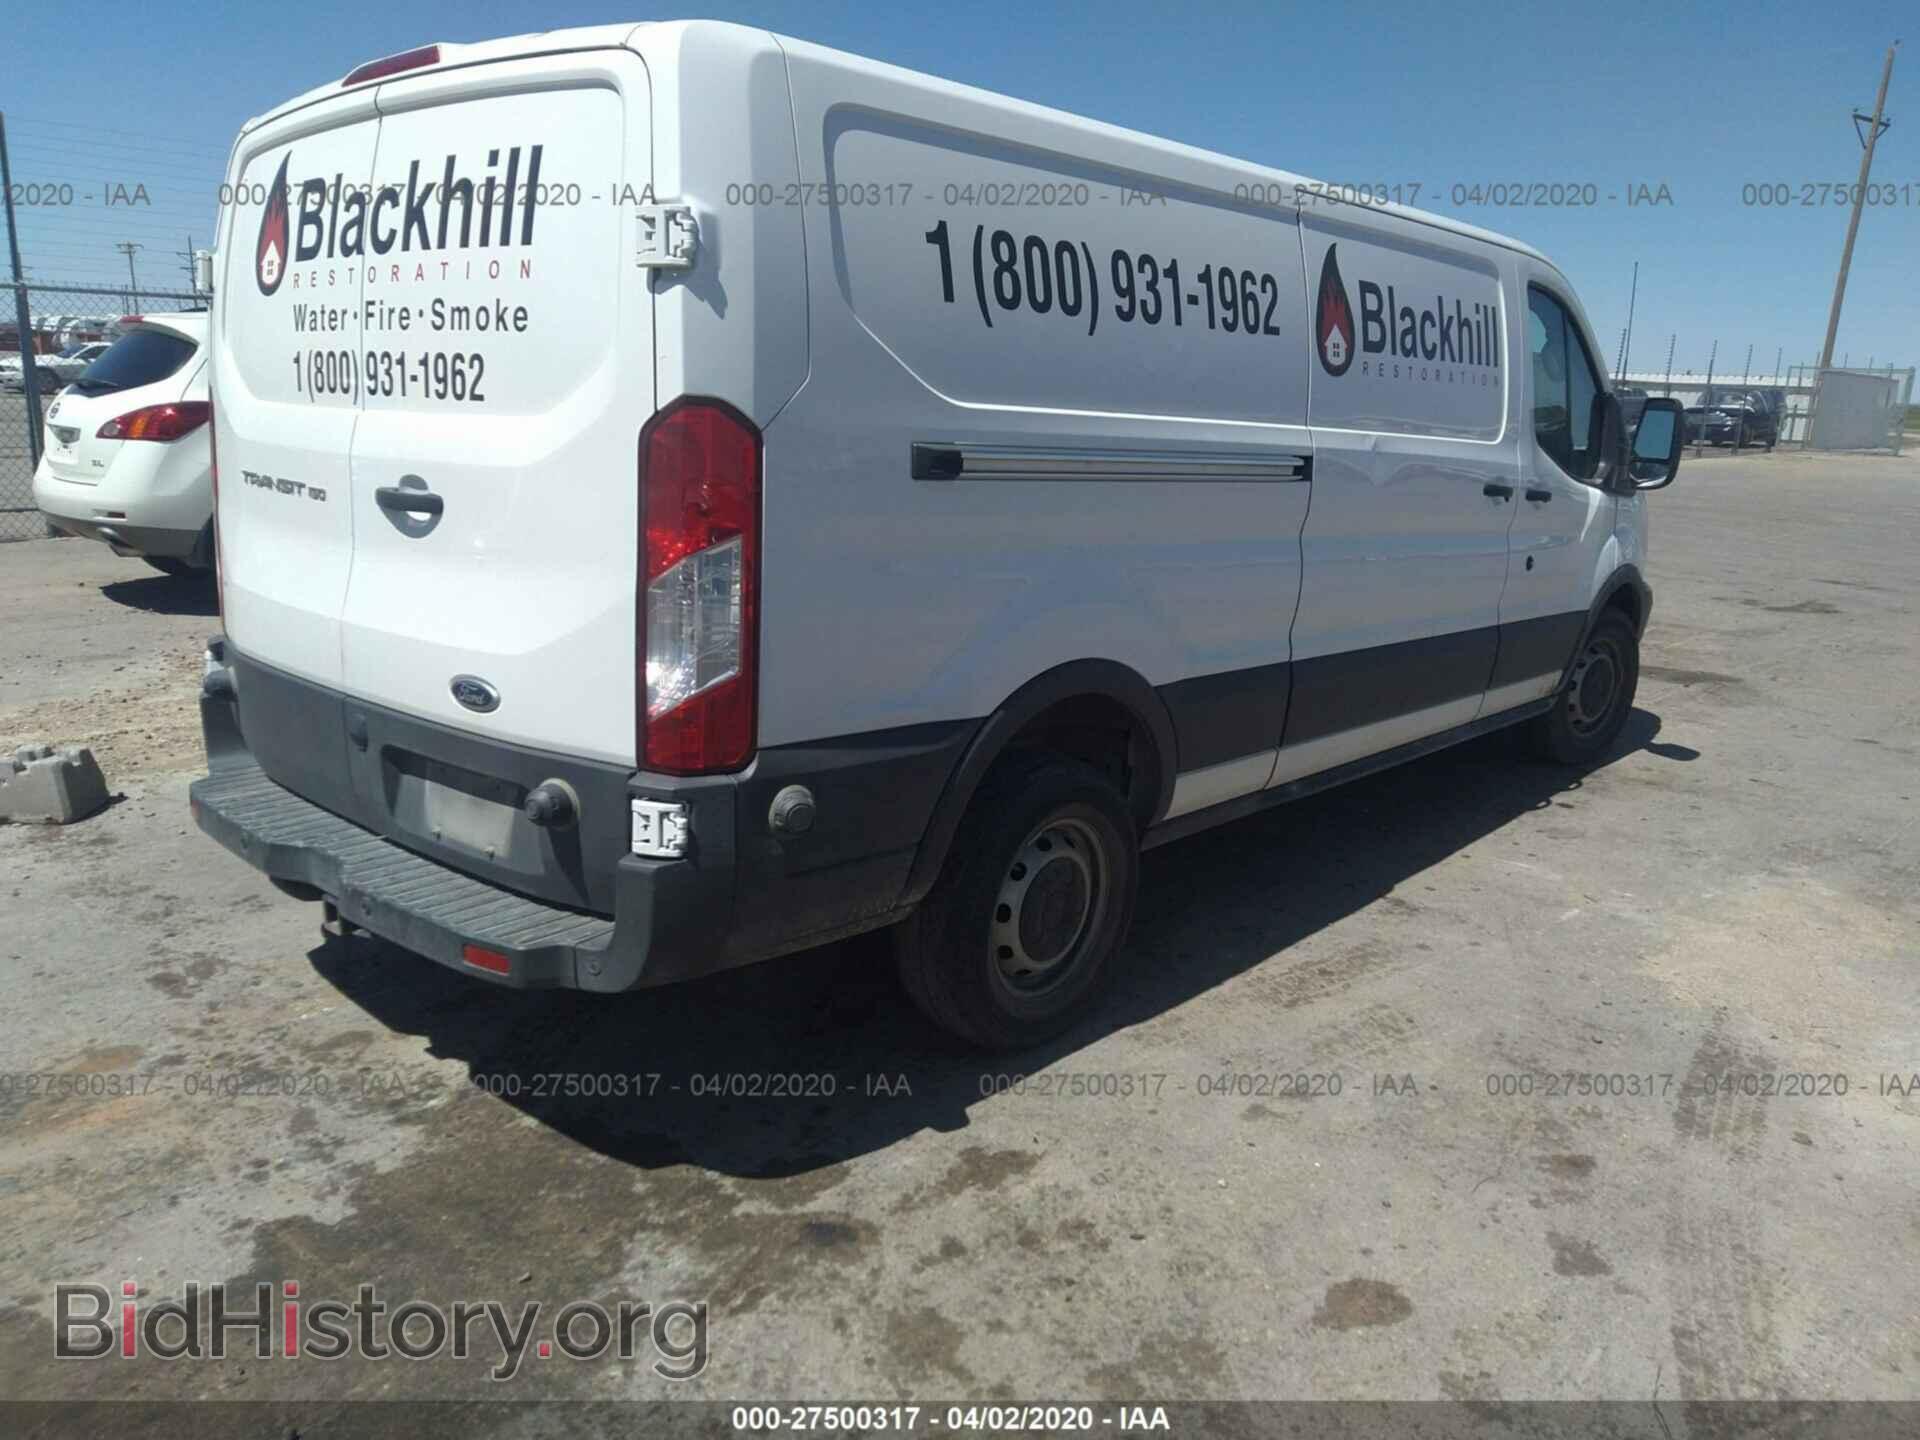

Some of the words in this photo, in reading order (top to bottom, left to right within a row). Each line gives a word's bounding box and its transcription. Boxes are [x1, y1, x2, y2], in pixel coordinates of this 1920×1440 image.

[294, 144, 543, 262] Blackhill
[293, 259, 531, 288] RESTORATION
[925, 220, 955, 303] 1
[973, 224, 1099, 336] (800)
[1111, 249, 1281, 336] 931-1962
[293, 303, 348, 332] Water
[365, 300, 410, 330] Fire
[431, 298, 529, 332] Smoke
[1358, 279, 1499, 368] Blackhill
[293, 350, 302, 392] 1
[307, 349, 359, 405] (800)
[365, 350, 485, 402] 931-1962
